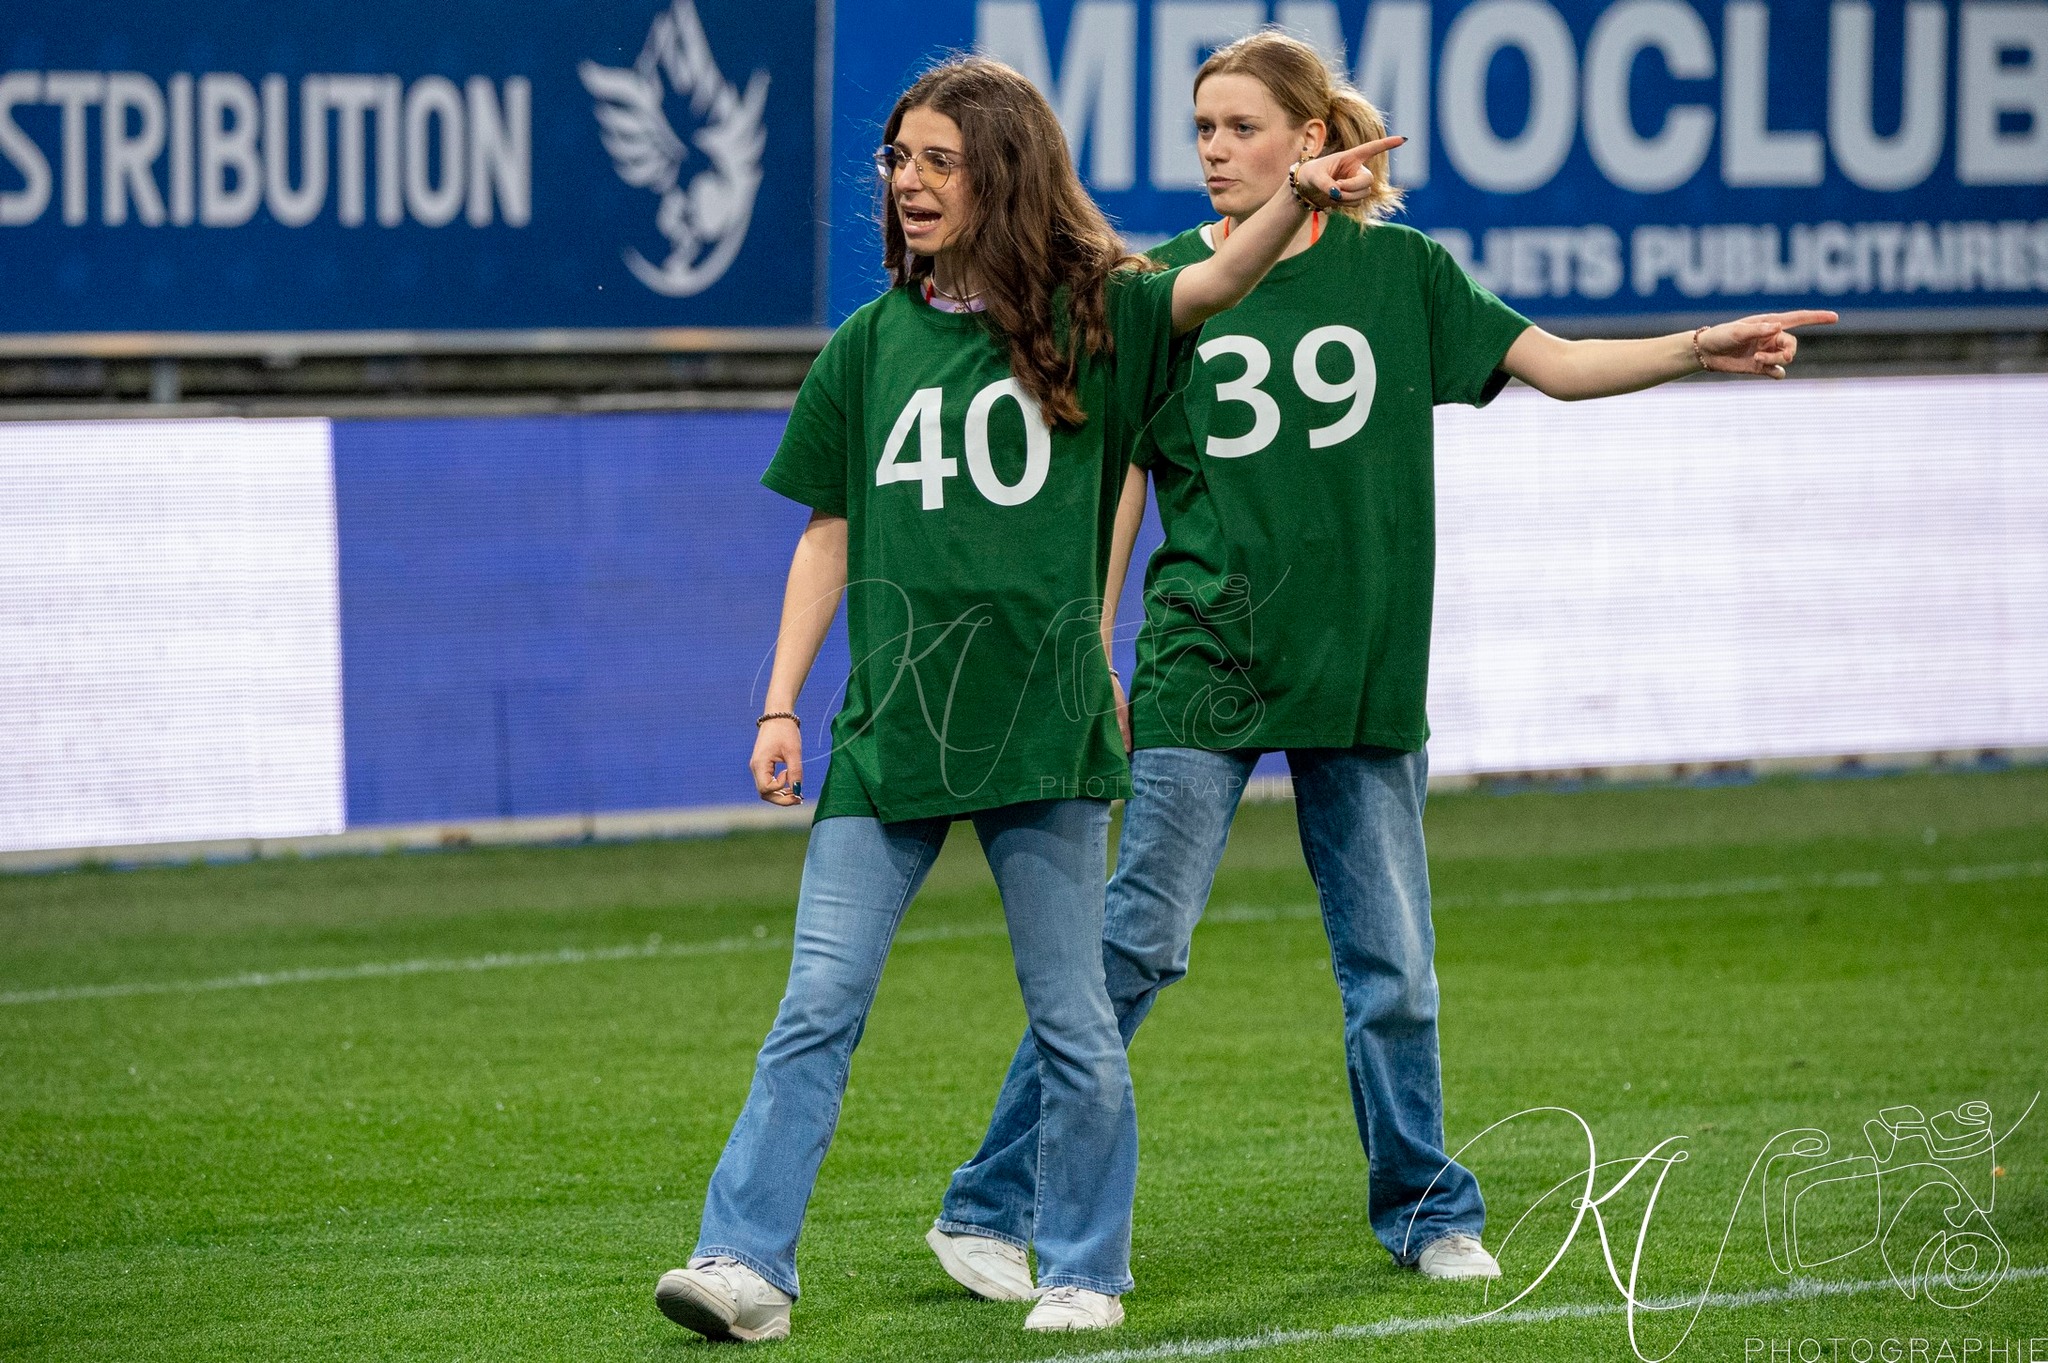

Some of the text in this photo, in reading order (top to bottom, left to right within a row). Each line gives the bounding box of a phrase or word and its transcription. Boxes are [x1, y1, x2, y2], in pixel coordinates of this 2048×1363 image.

[0, 70, 532, 228] STRIBUTION
[1631, 220, 2048, 297] PUBLICITAIRE
[876, 376, 1051, 511] 40
[1197, 324, 1377, 459] 39
